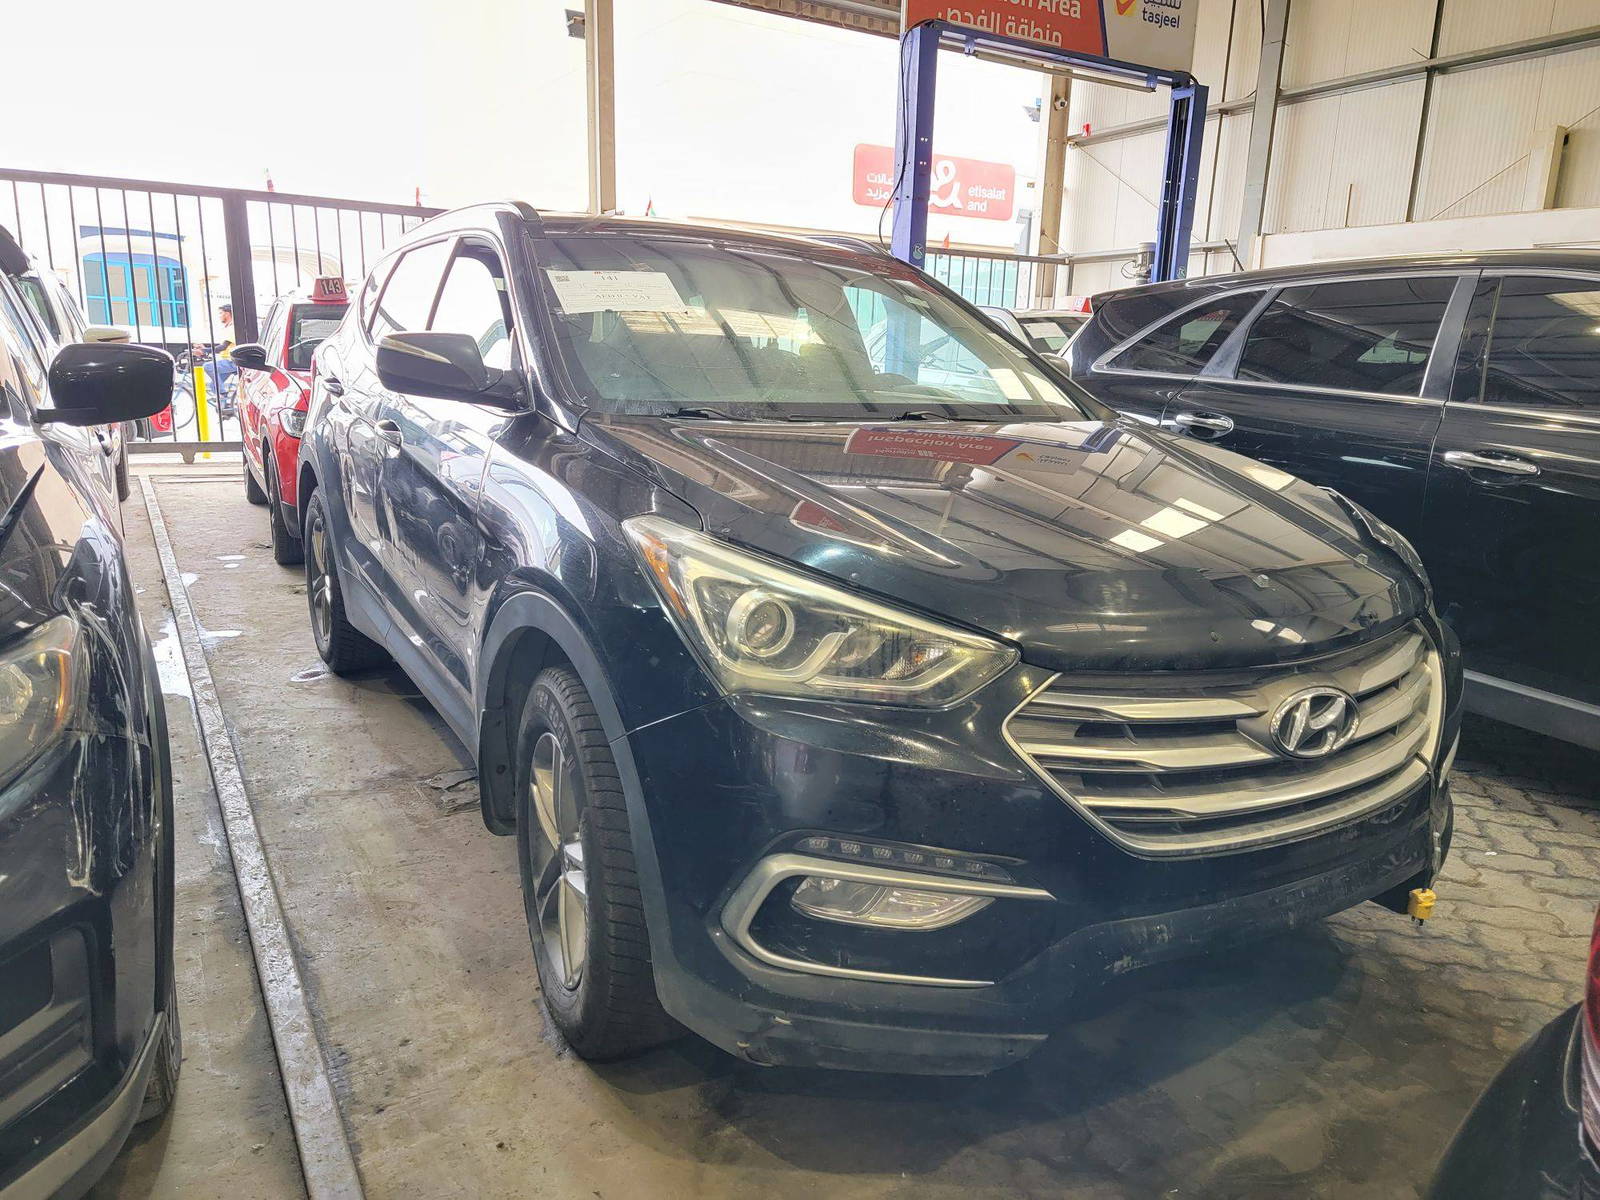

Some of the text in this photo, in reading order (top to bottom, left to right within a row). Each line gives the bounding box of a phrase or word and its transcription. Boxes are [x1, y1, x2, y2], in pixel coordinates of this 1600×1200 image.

[1142, 7, 1180, 29] tasjeel
[1005, 16, 1063, 47] منطقة
[967, 184, 1006, 200] etisalat
[966, 200, 988, 213] and
